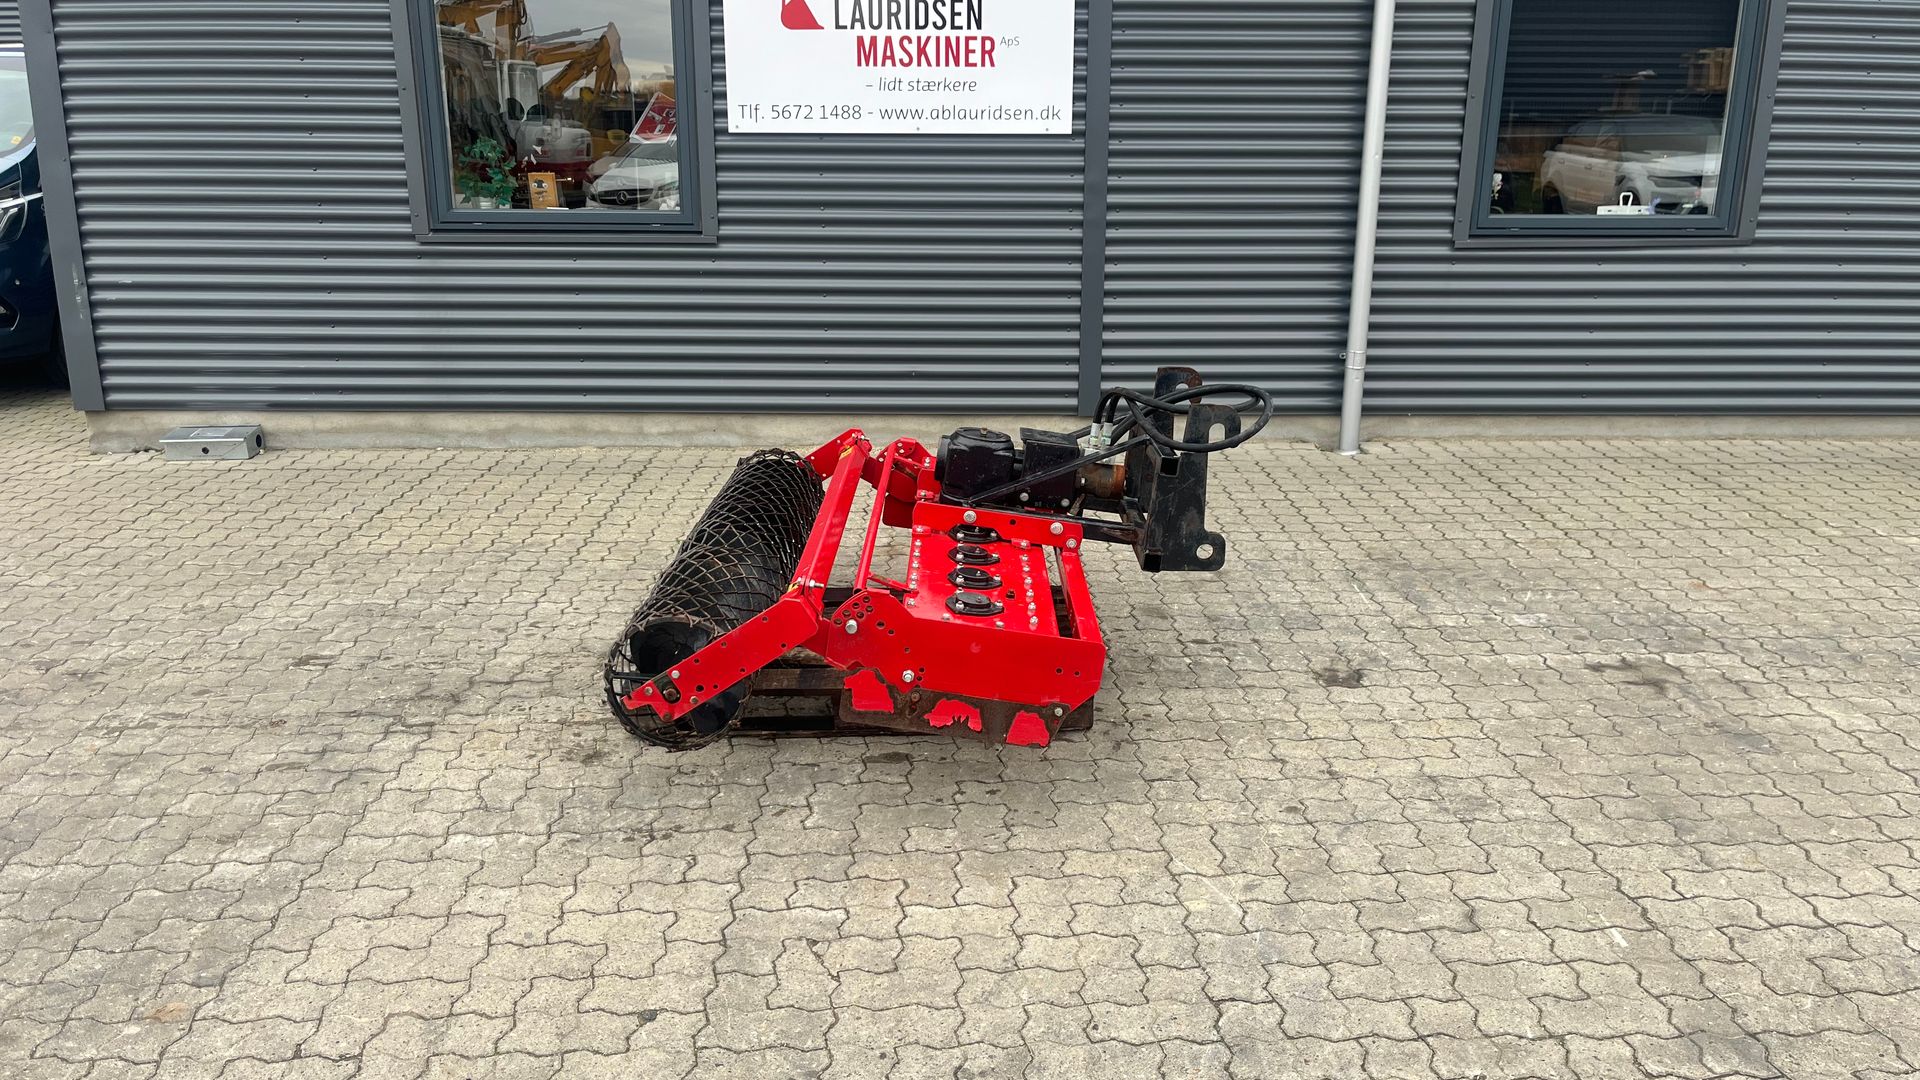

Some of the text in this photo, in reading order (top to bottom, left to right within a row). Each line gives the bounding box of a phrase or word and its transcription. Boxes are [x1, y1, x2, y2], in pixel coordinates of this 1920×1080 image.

[834, 0, 983, 30] LAURIDSEN
[856, 35, 1020, 67] MASKINER ApS
[878, 77, 903, 92] lidt
[907, 77, 977, 92] stærkere
[738, 104, 765, 123] Tlf.
[771, 105, 813, 120] 5672
[819, 105, 862, 120] 1488
[879, 105, 1061, 120] www.ablauridsen.dk
